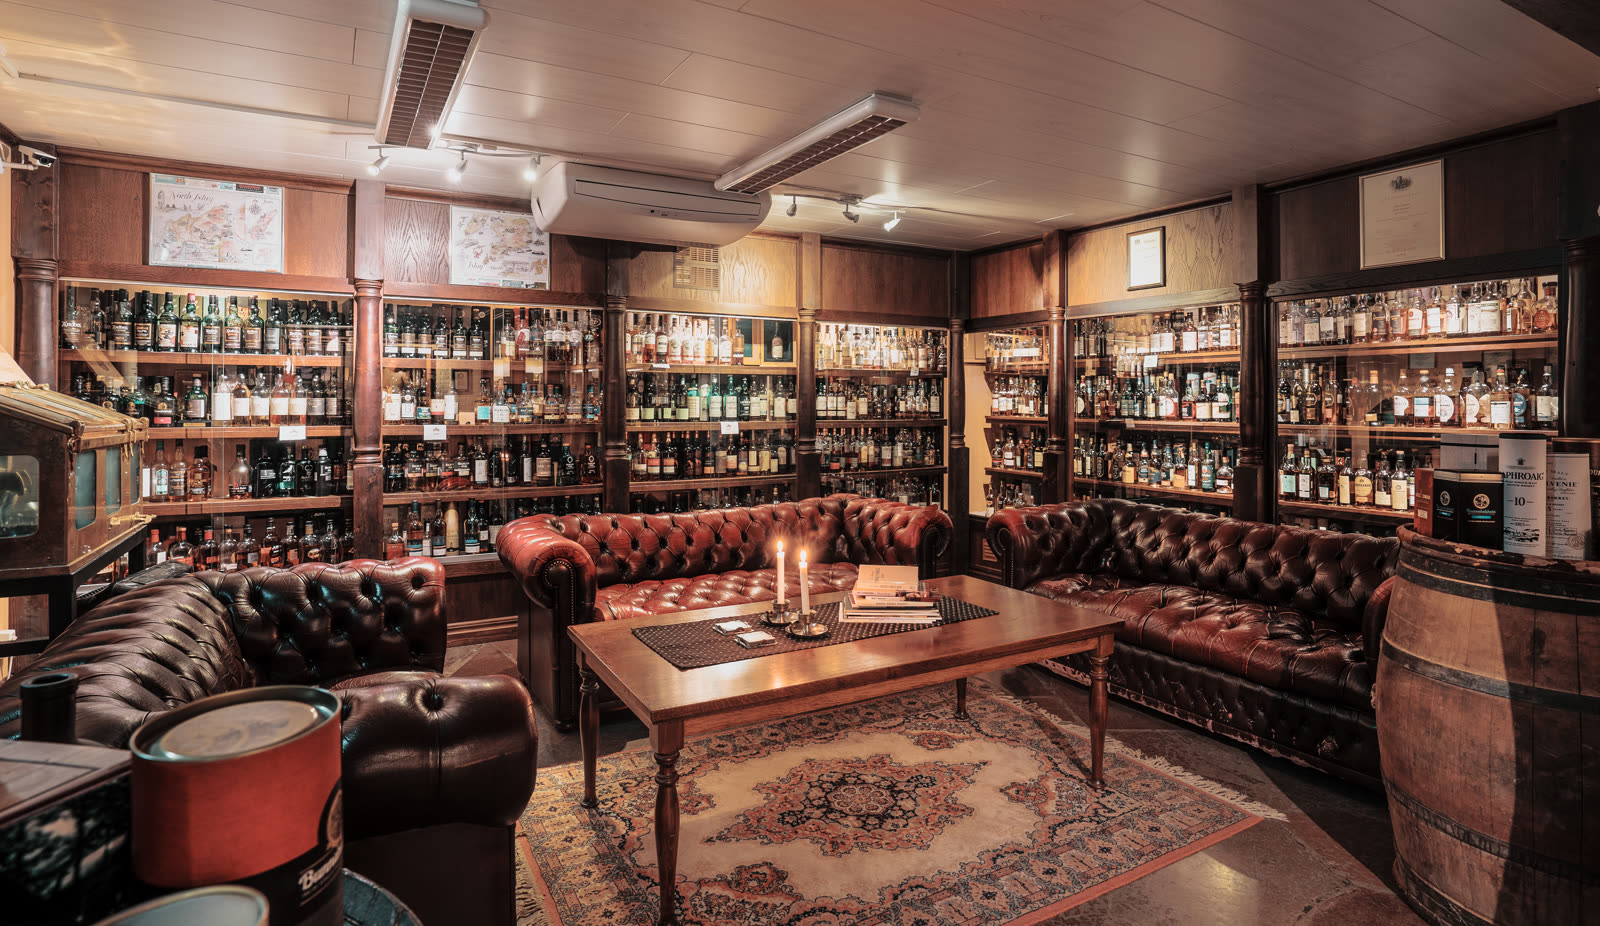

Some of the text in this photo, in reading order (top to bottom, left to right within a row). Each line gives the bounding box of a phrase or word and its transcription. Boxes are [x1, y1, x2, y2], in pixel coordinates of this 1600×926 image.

[170, 191, 214, 203] North Islay
[1514, 496, 1526, 506] 10
